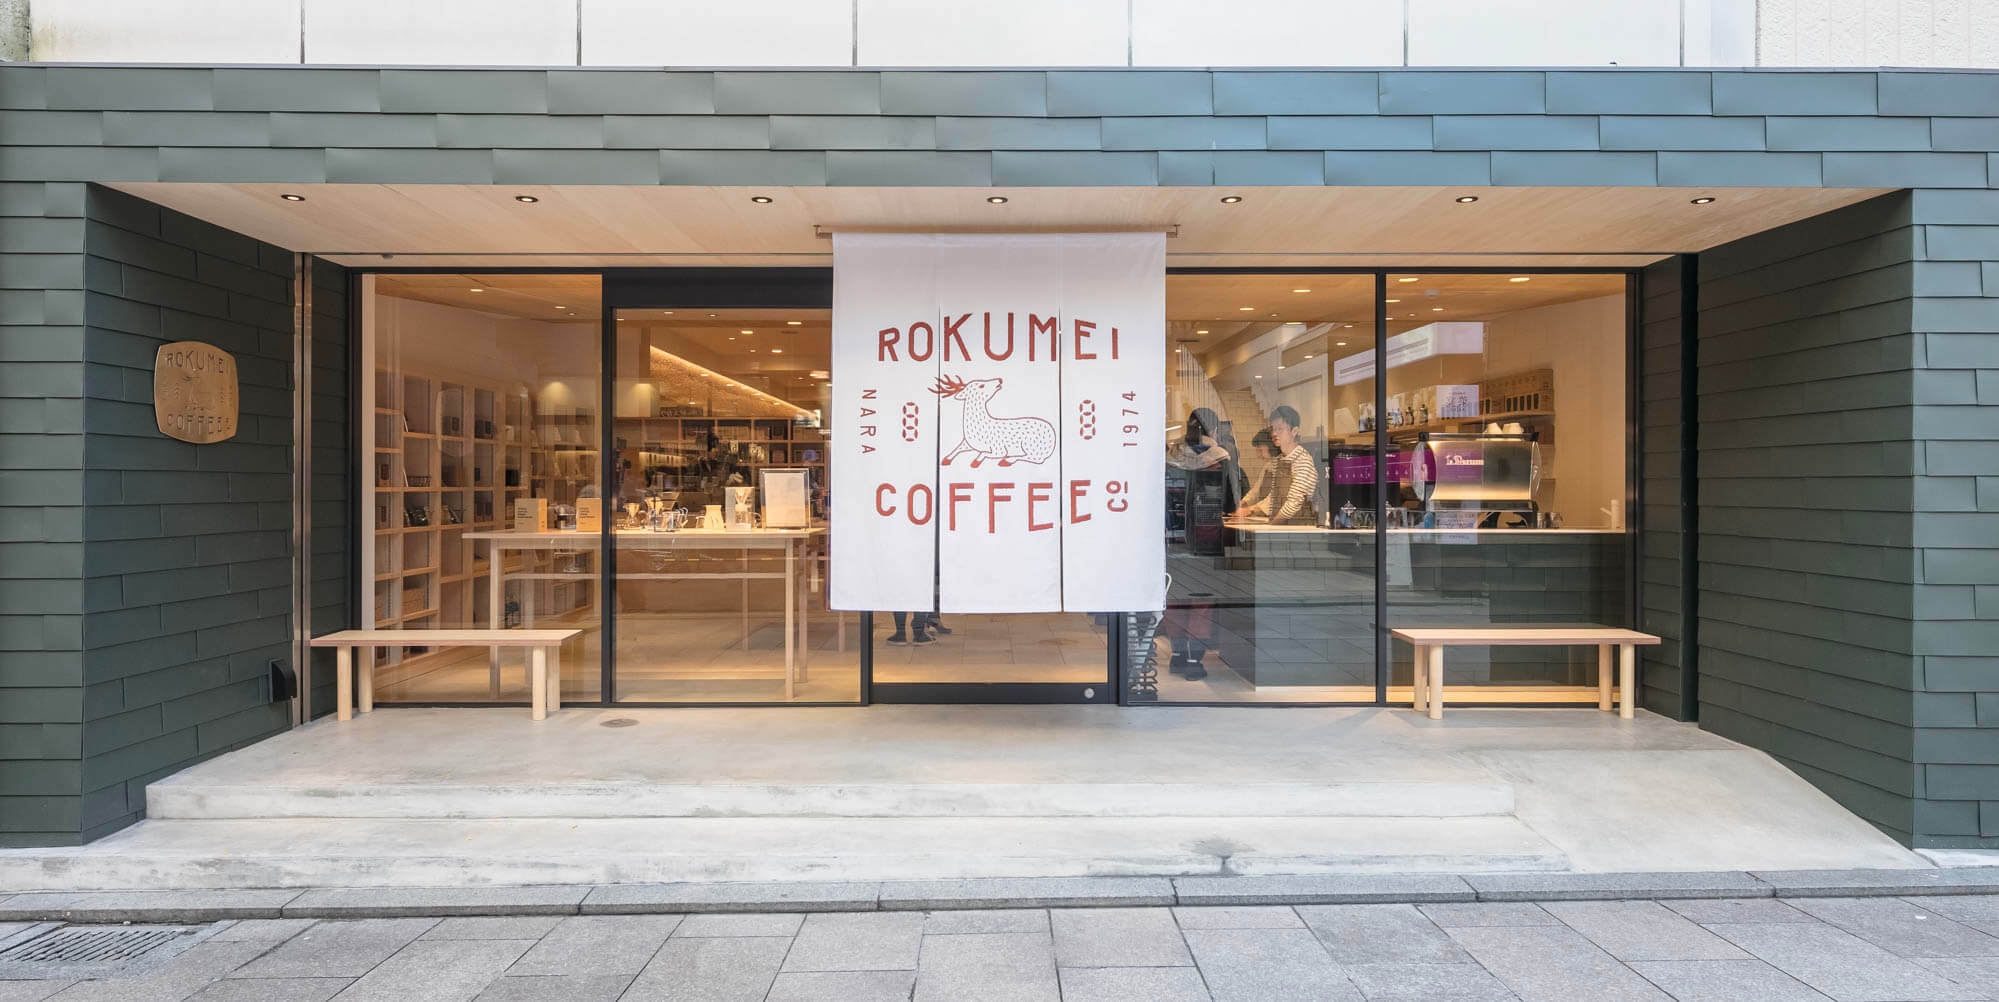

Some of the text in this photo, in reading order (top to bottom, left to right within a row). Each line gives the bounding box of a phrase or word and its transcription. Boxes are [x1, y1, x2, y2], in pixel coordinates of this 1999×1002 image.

[877, 311, 1119, 362] ROKUMEI
[167, 413, 223, 435] COFFEE
[860, 389, 877, 454] NARA
[1122, 391, 1139, 447] 1974
[875, 479, 1092, 534] COFFEE
